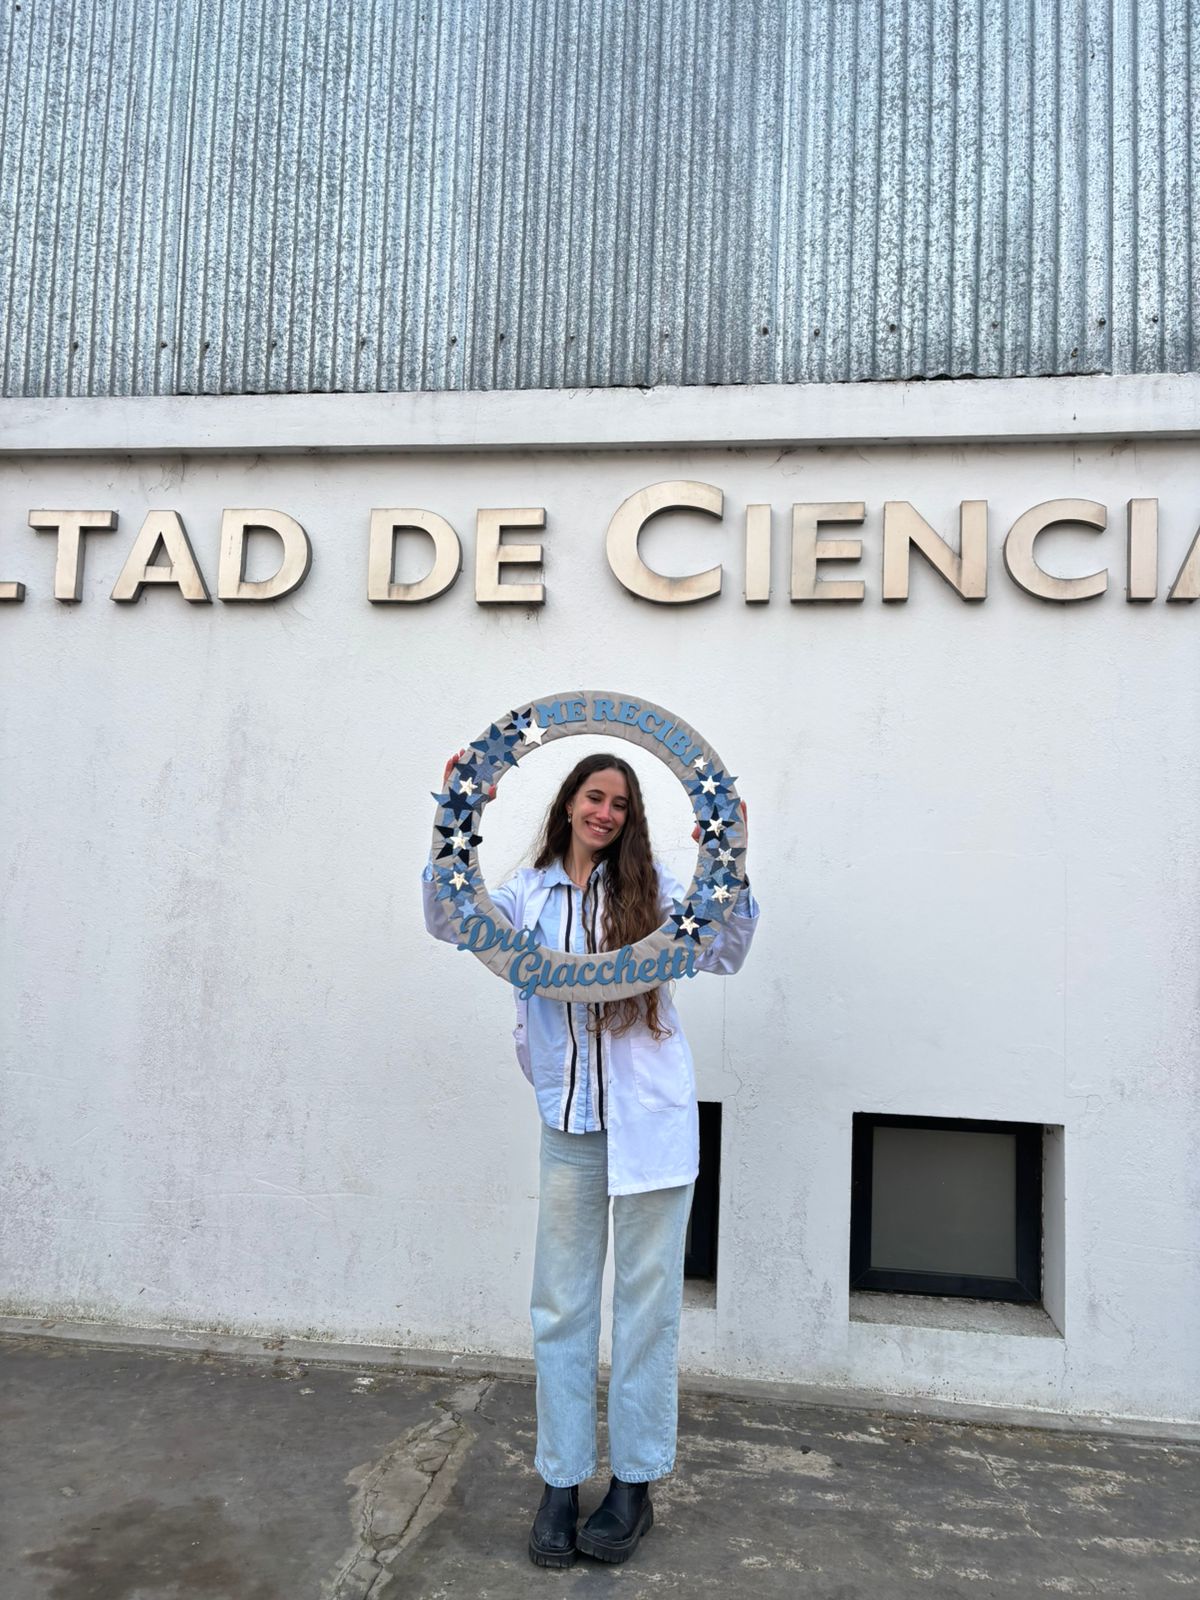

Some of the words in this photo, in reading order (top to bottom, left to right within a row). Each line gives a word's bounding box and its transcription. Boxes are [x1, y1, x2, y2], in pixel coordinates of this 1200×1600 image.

[0, 508, 313, 604] TAD
[367, 507, 548, 605] DE
[535, 698, 588, 729] ME
[592, 698, 704, 767] RECIBI
[457, 914, 542, 952] Dra
[508, 943, 700, 1001] Giacchetti
